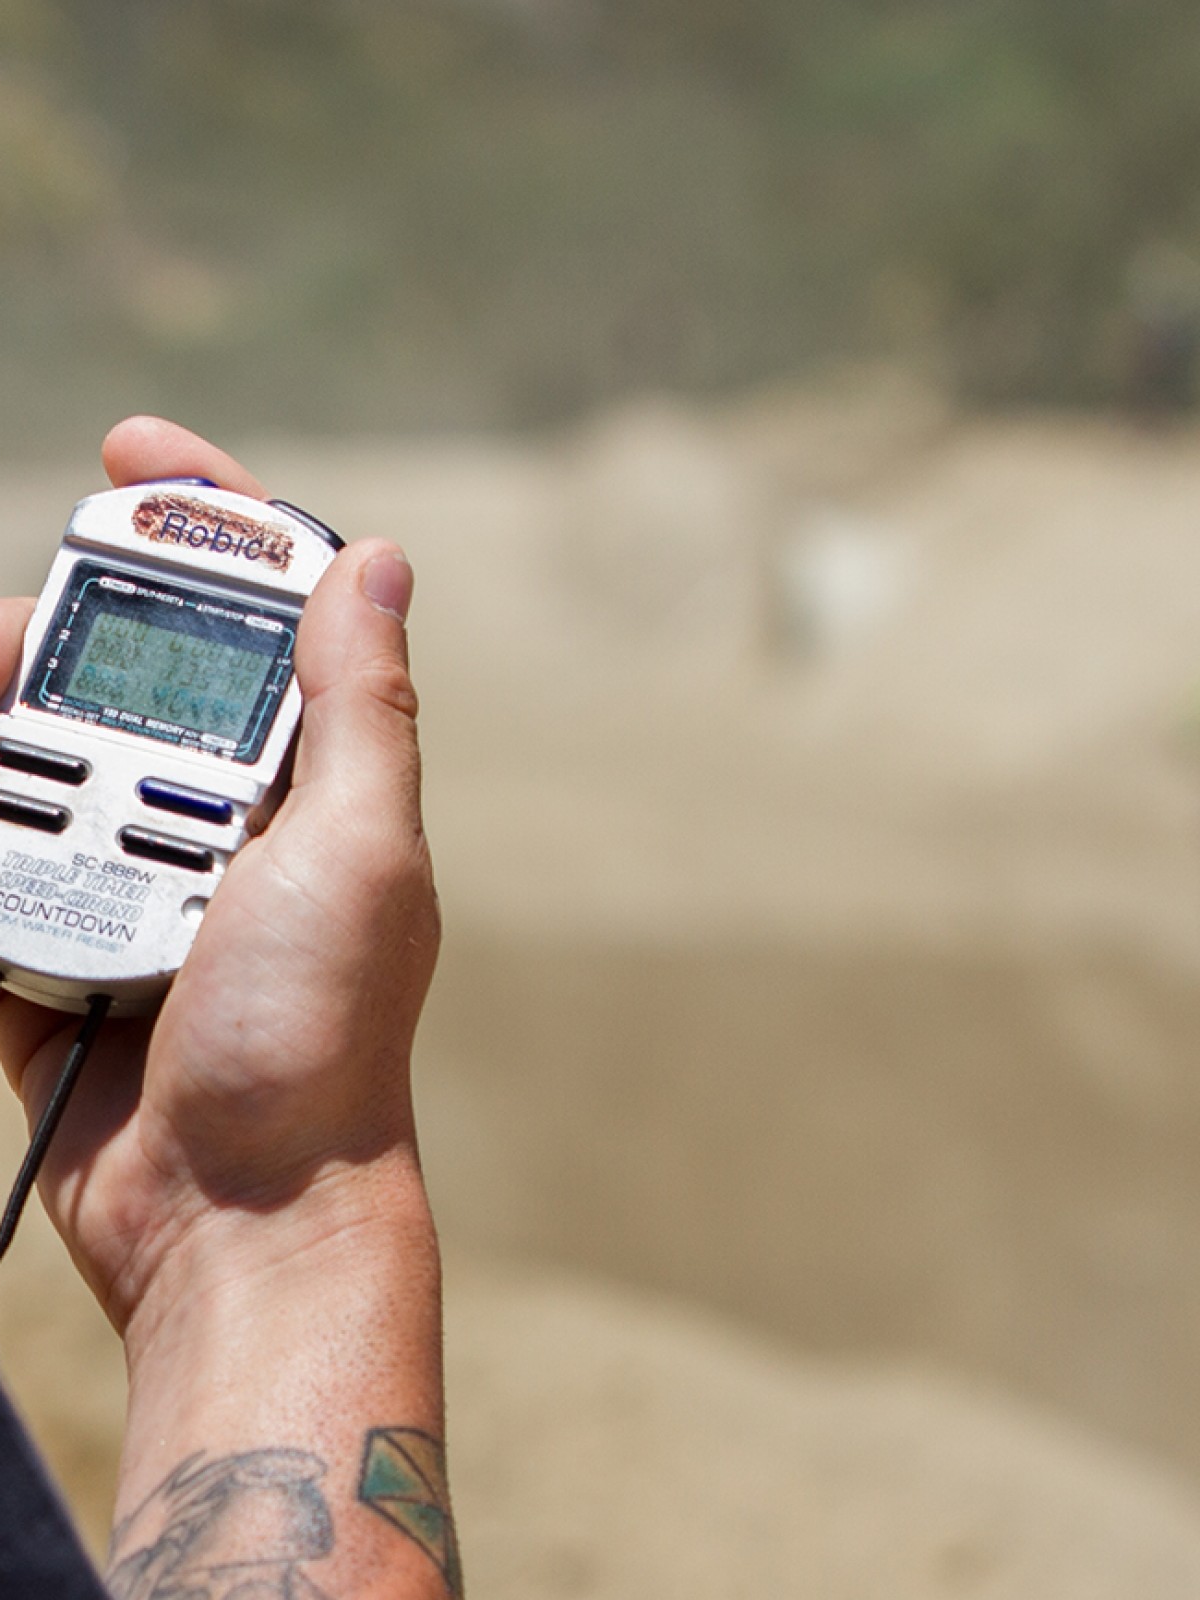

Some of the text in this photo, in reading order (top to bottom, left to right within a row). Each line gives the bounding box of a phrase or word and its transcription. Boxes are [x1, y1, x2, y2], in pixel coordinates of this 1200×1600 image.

[159, 511, 264, 561] Robic
[71, 602, 80, 613] 1
[59, 629, 71, 640] 2
[47, 657, 58, 669] 3
[1, 850, 153, 904] TRIPLE TIMER
[22, 918, 73, 940] WATER
